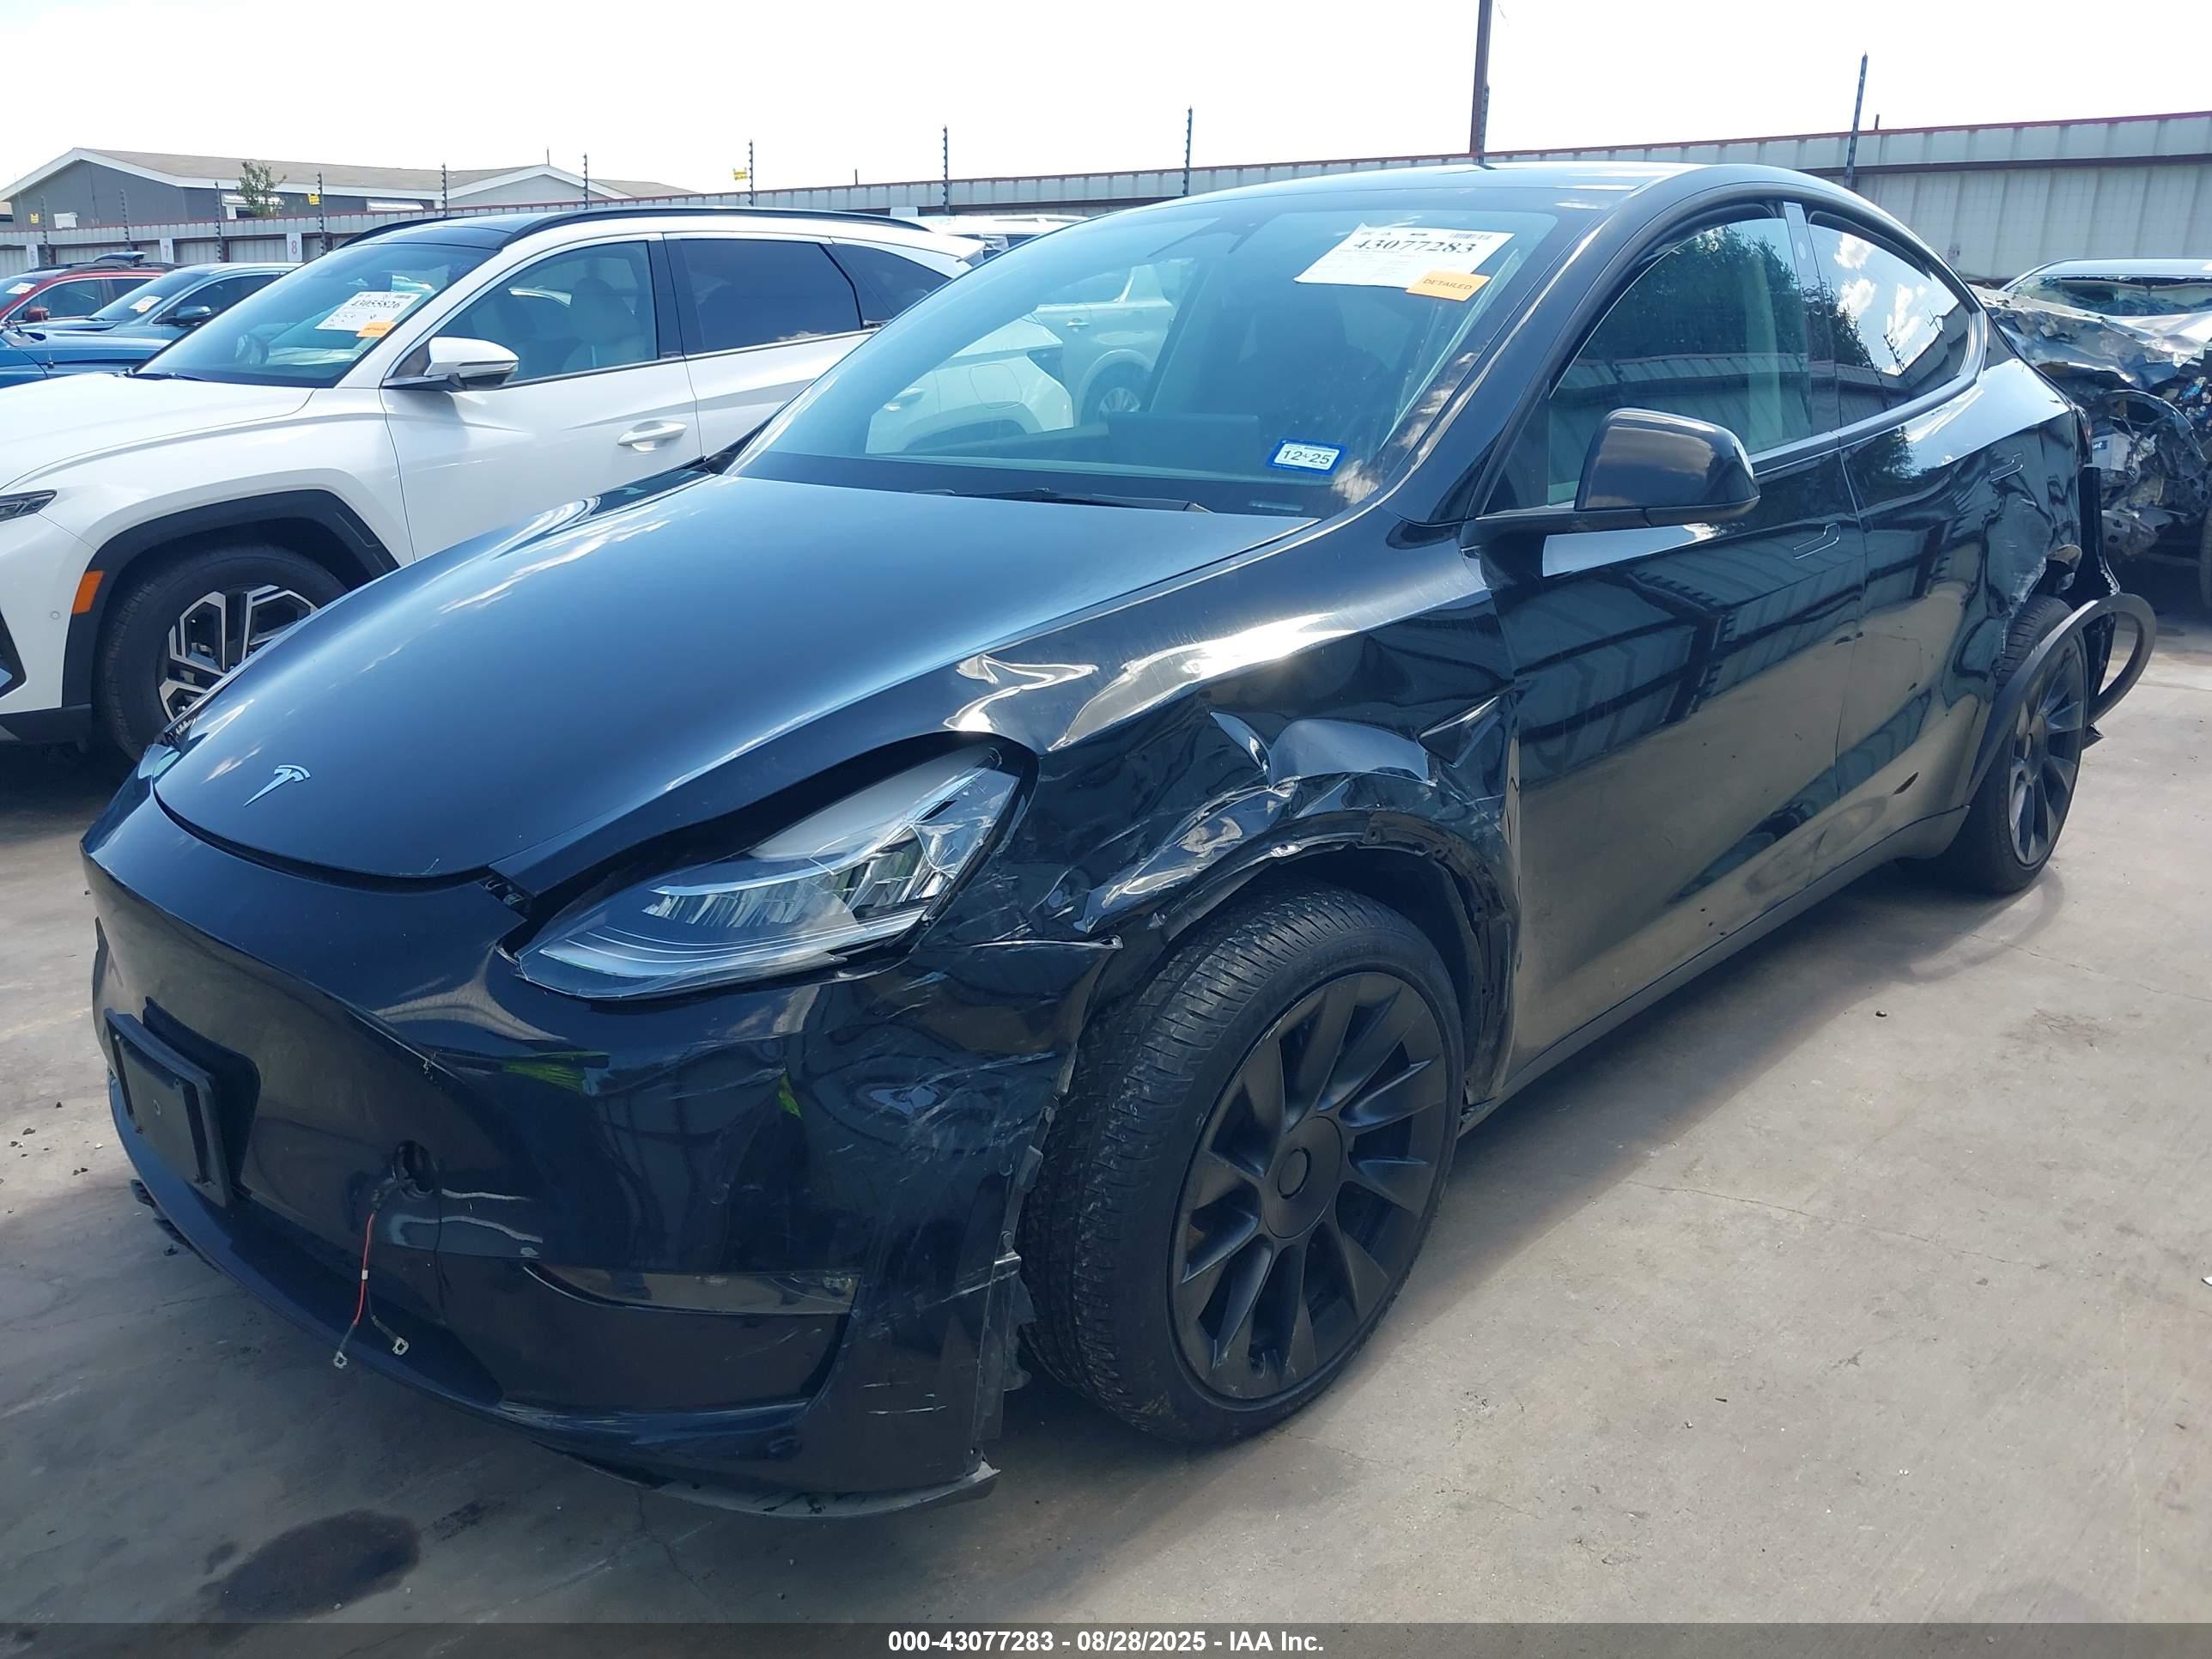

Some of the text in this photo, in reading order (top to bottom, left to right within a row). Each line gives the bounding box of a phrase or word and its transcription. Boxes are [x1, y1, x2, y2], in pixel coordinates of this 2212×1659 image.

[291, 240, 298, 255] 8
[1352, 240, 1477, 255] 43077283
[1422, 278, 1473, 290] DETAILED
